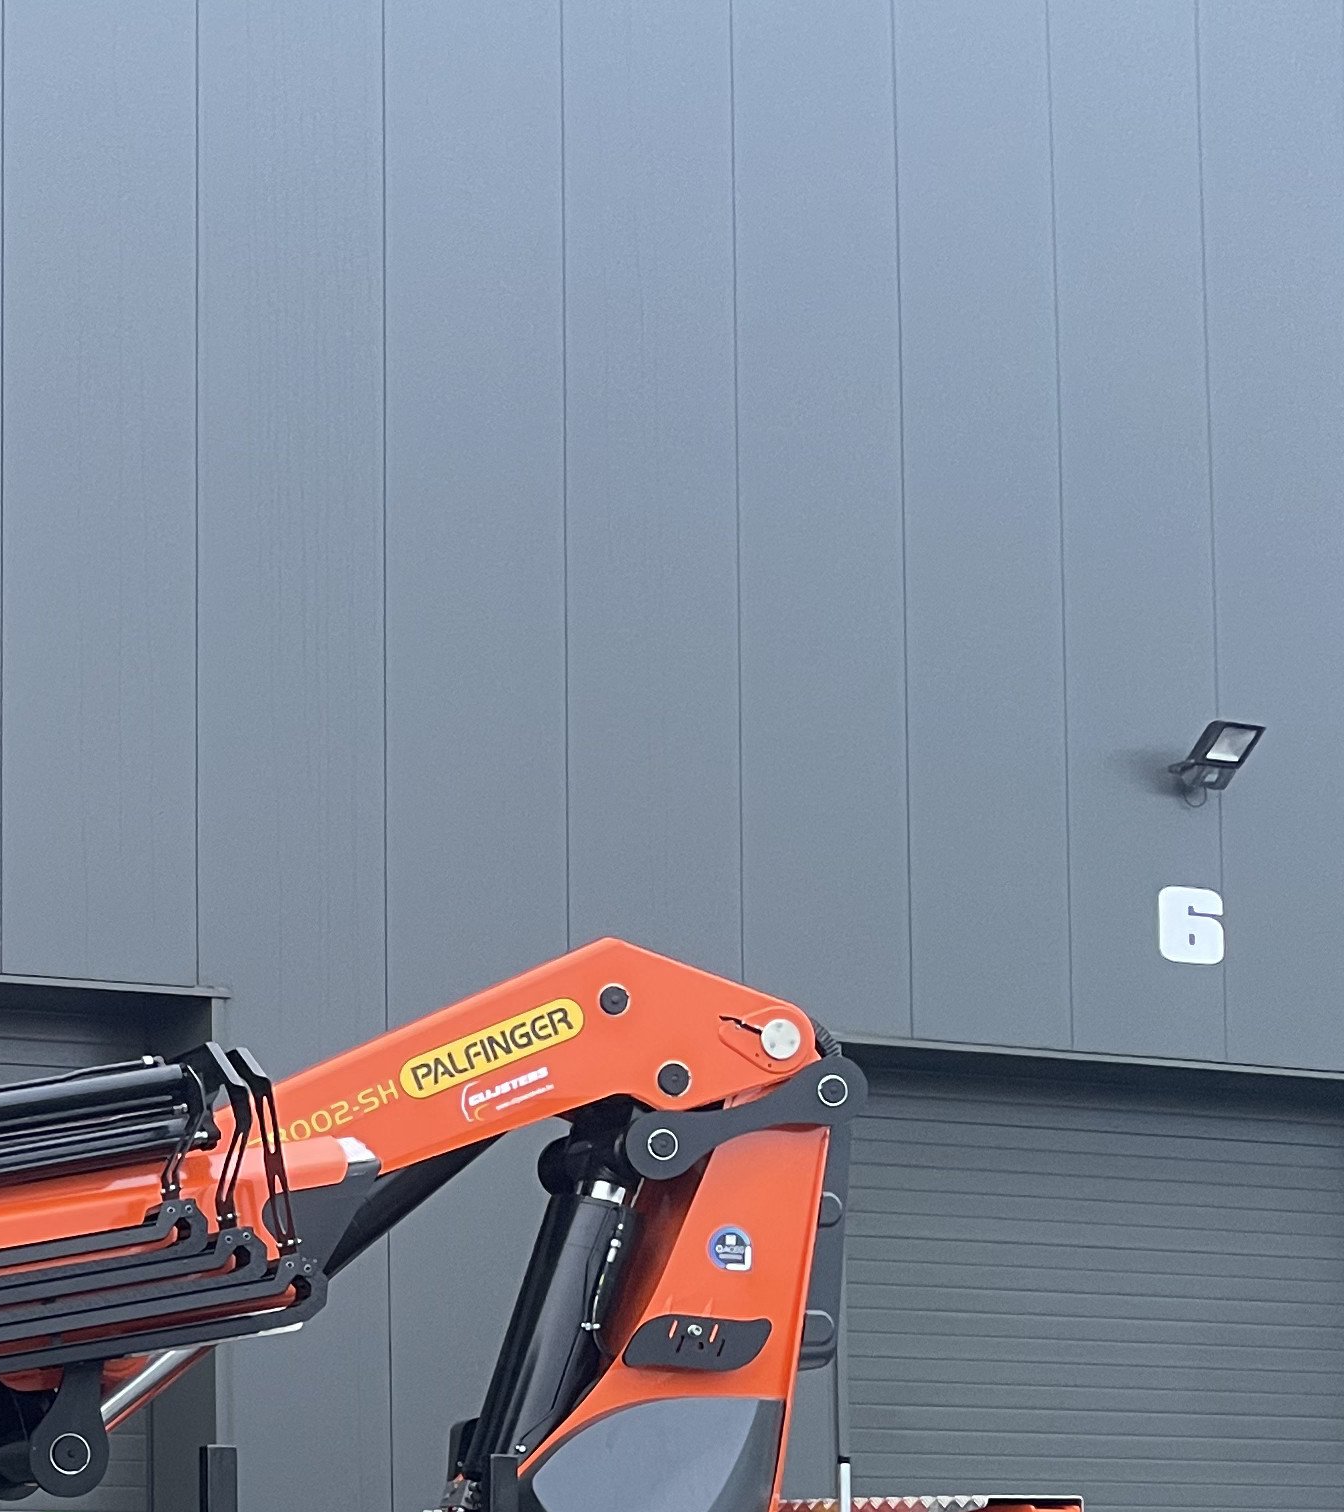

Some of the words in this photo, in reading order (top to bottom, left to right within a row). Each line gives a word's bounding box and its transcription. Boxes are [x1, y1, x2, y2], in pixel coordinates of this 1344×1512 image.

[1158, 885, 1225, 966] 6
[410, 1006, 574, 1091] PALFINGER
[247, 1079, 399, 1149] 002-SH
